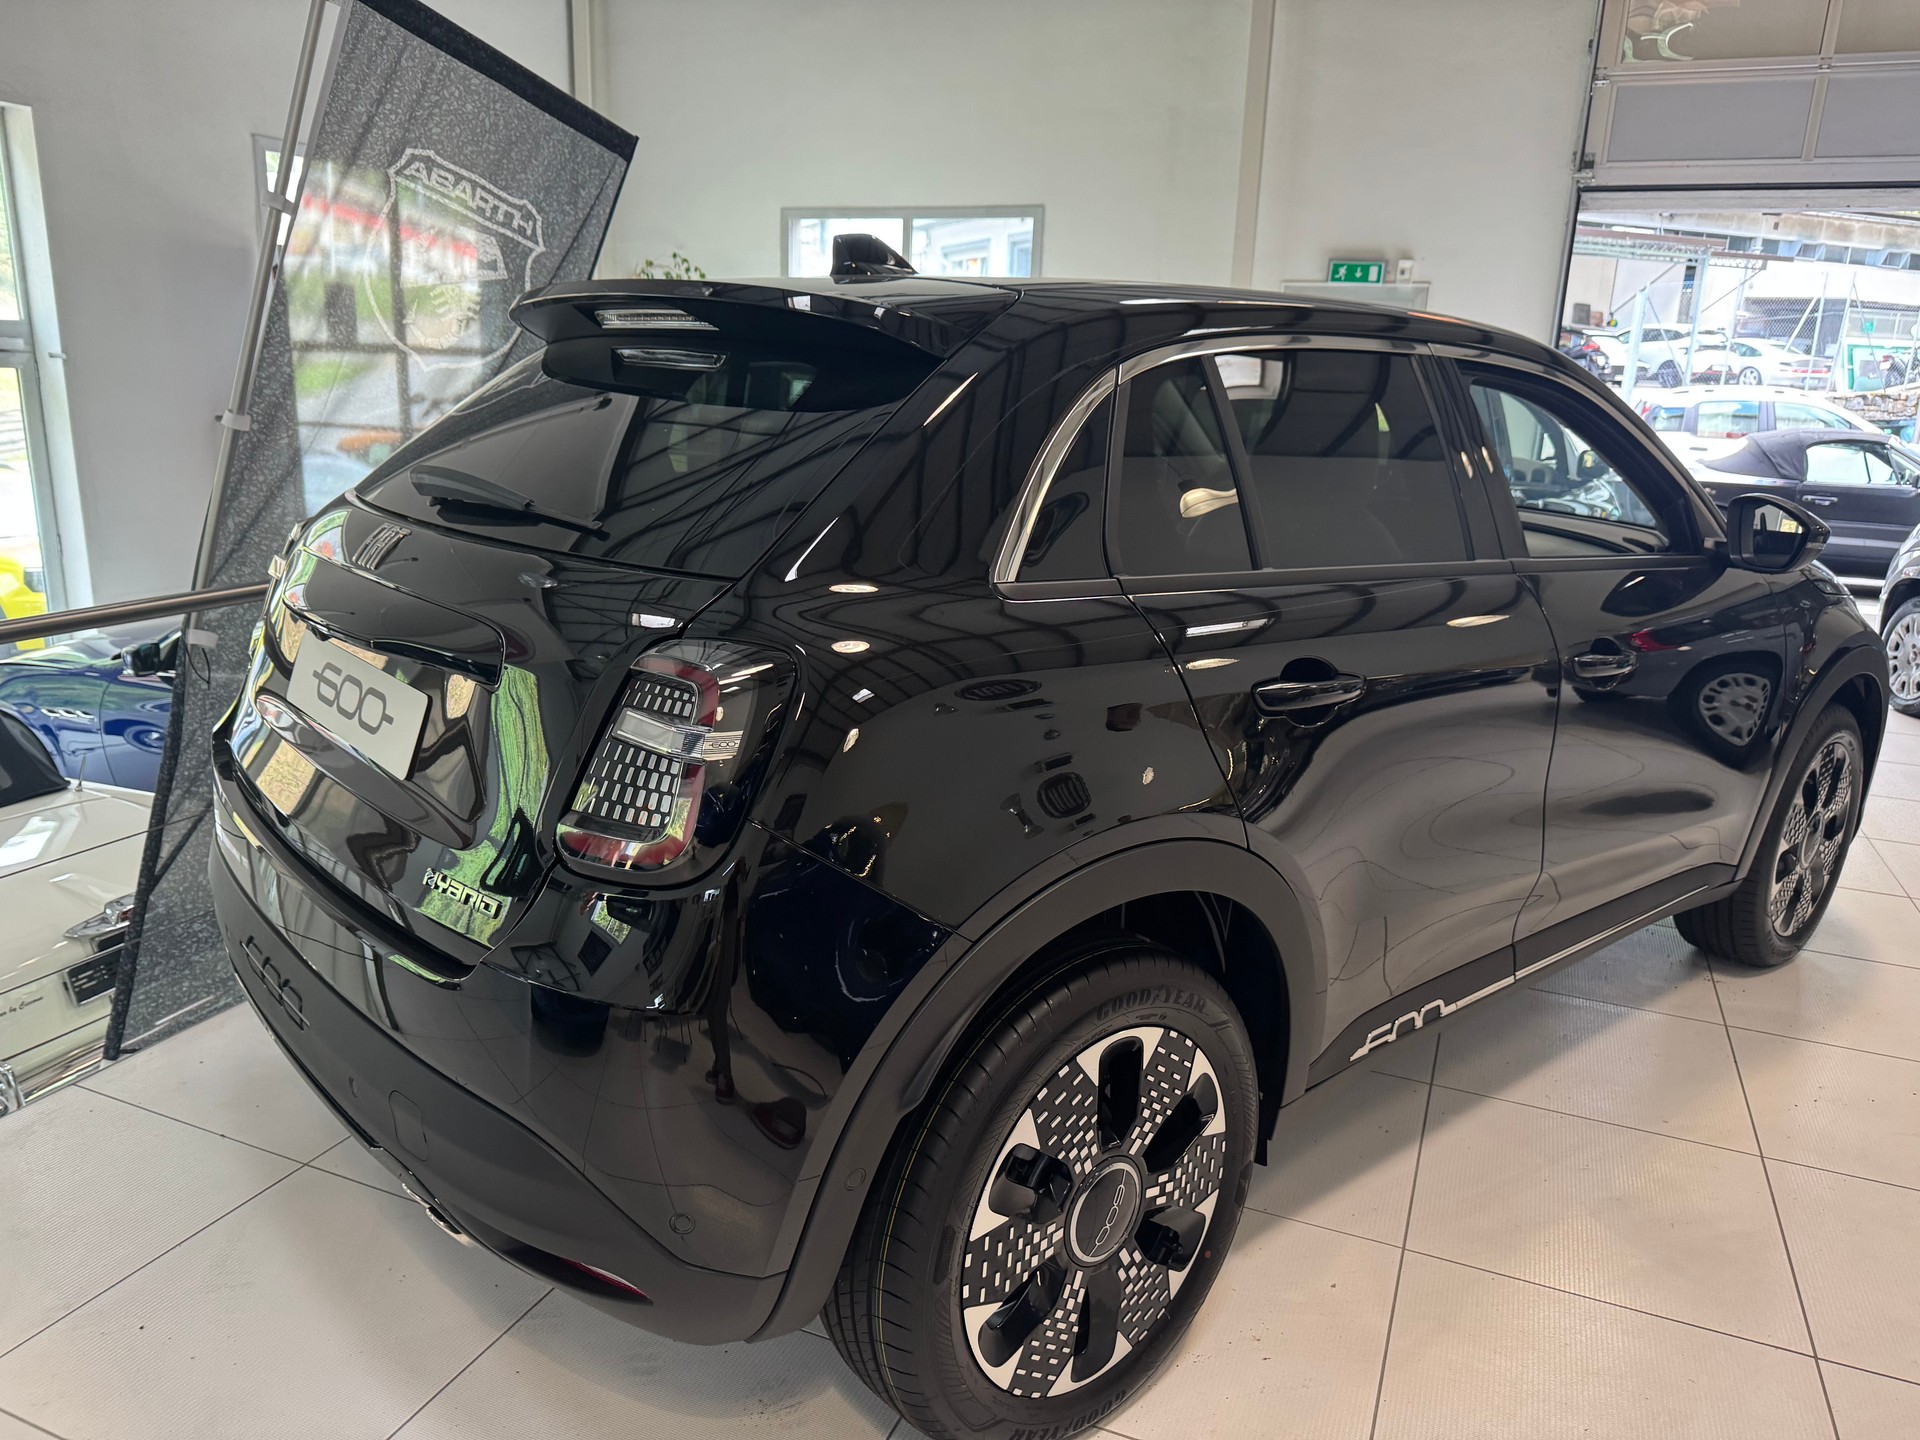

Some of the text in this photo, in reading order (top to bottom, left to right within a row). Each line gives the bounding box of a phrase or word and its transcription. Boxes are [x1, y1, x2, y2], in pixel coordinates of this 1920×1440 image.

[403, 161, 533, 237] ABARTH
[312, 661, 394, 735] 600
[709, 740, 738, 749] 600
[1095, 1184, 1126, 1246] 600
